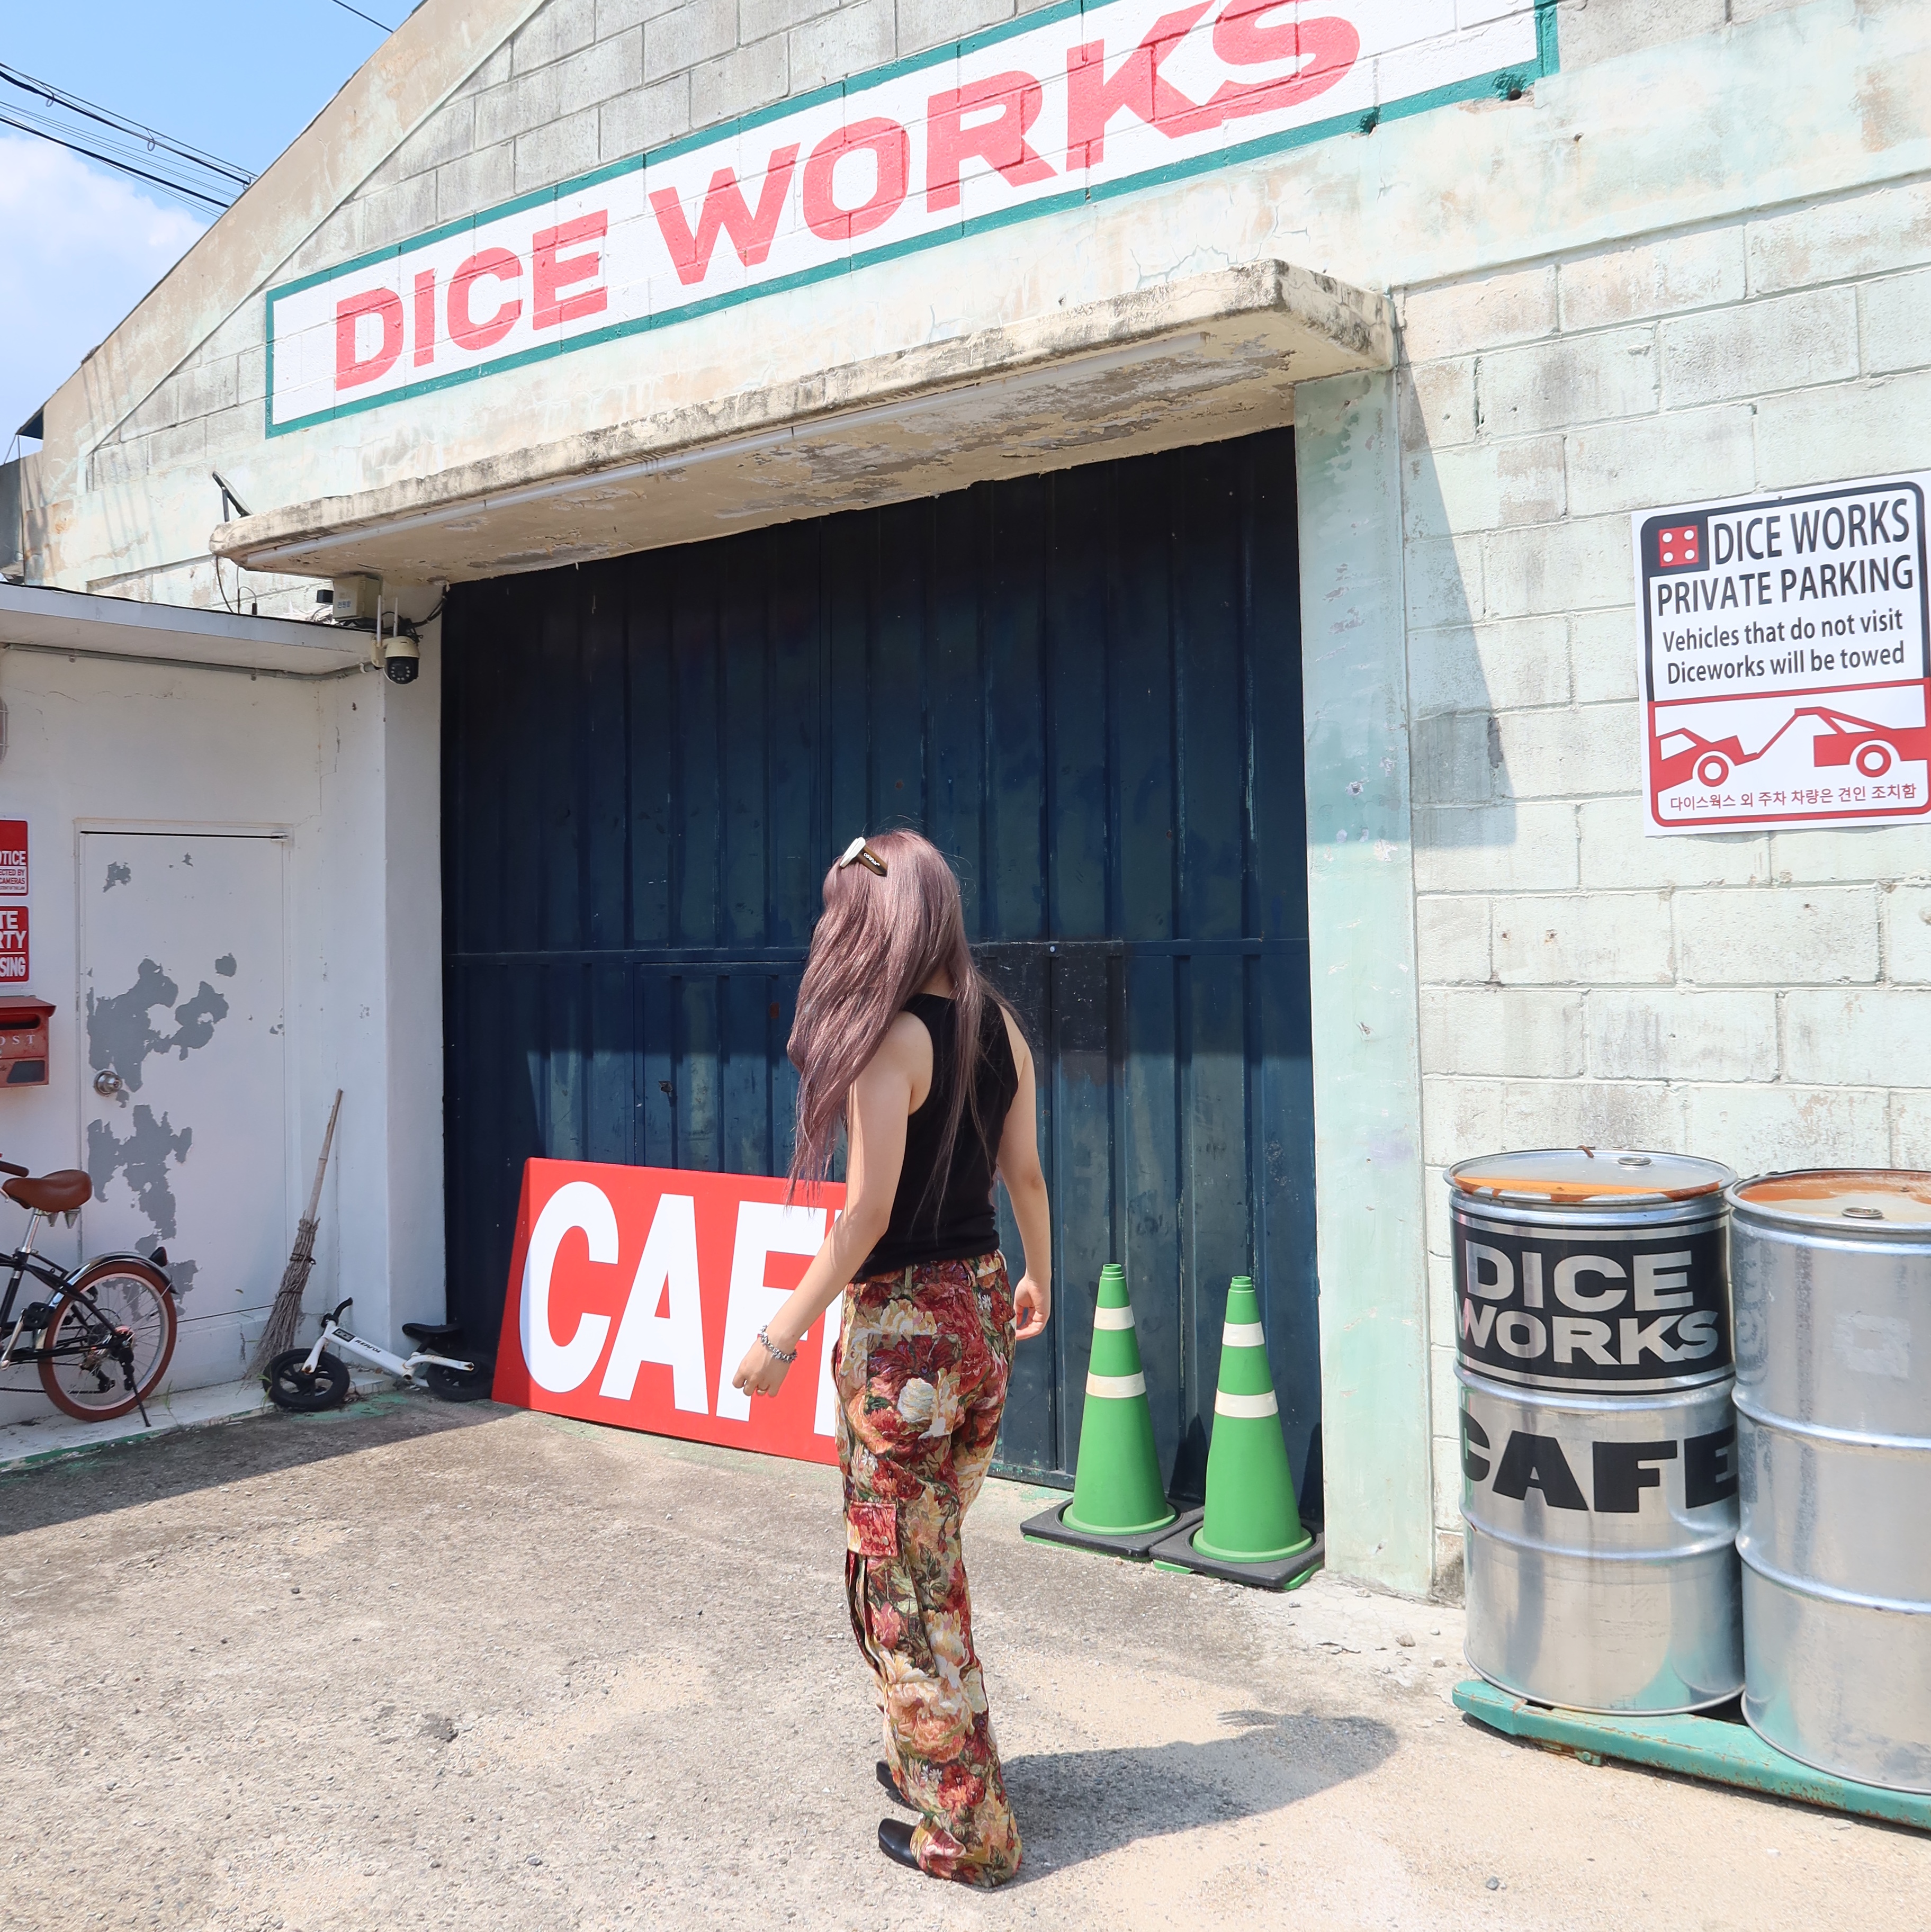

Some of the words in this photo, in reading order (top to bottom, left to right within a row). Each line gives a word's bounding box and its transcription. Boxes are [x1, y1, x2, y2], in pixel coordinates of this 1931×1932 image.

[336, 209, 608, 391] DICE
[648, 0, 1360, 285] WORKS
[1714, 515, 1783, 565] DICE
[1790, 498, 1910, 554] WORKS
[1657, 571, 1773, 616] PRIVATE
[1781, 554, 1913, 603] PARKING
[1663, 625, 1739, 652] Vehicles
[1744, 621, 1785, 644] that
[1790, 617, 1815, 640] do
[1821, 614, 1855, 637] not
[1860, 607, 1903, 634] visit
[1667, 654, 1765, 685] Diceworks
[1770, 650, 1805, 675] will
[1810, 649, 1835, 672] be
[1840, 640, 1905, 668] towed
[1740, 793, 1754, 808] 외
[1758, 790, 1786, 807] 주차
[1791, 787, 1834, 805] 차량은
[1838, 786, 1866, 802] 견인
[1871, 783, 1917, 800] 조치함
[0, 850, 26, 866] TICE
[1465, 1239, 1694, 1313] DICE
[1454, 1290, 1718, 1365] WORKS
[1459, 1406, 1738, 1513] CAFE
